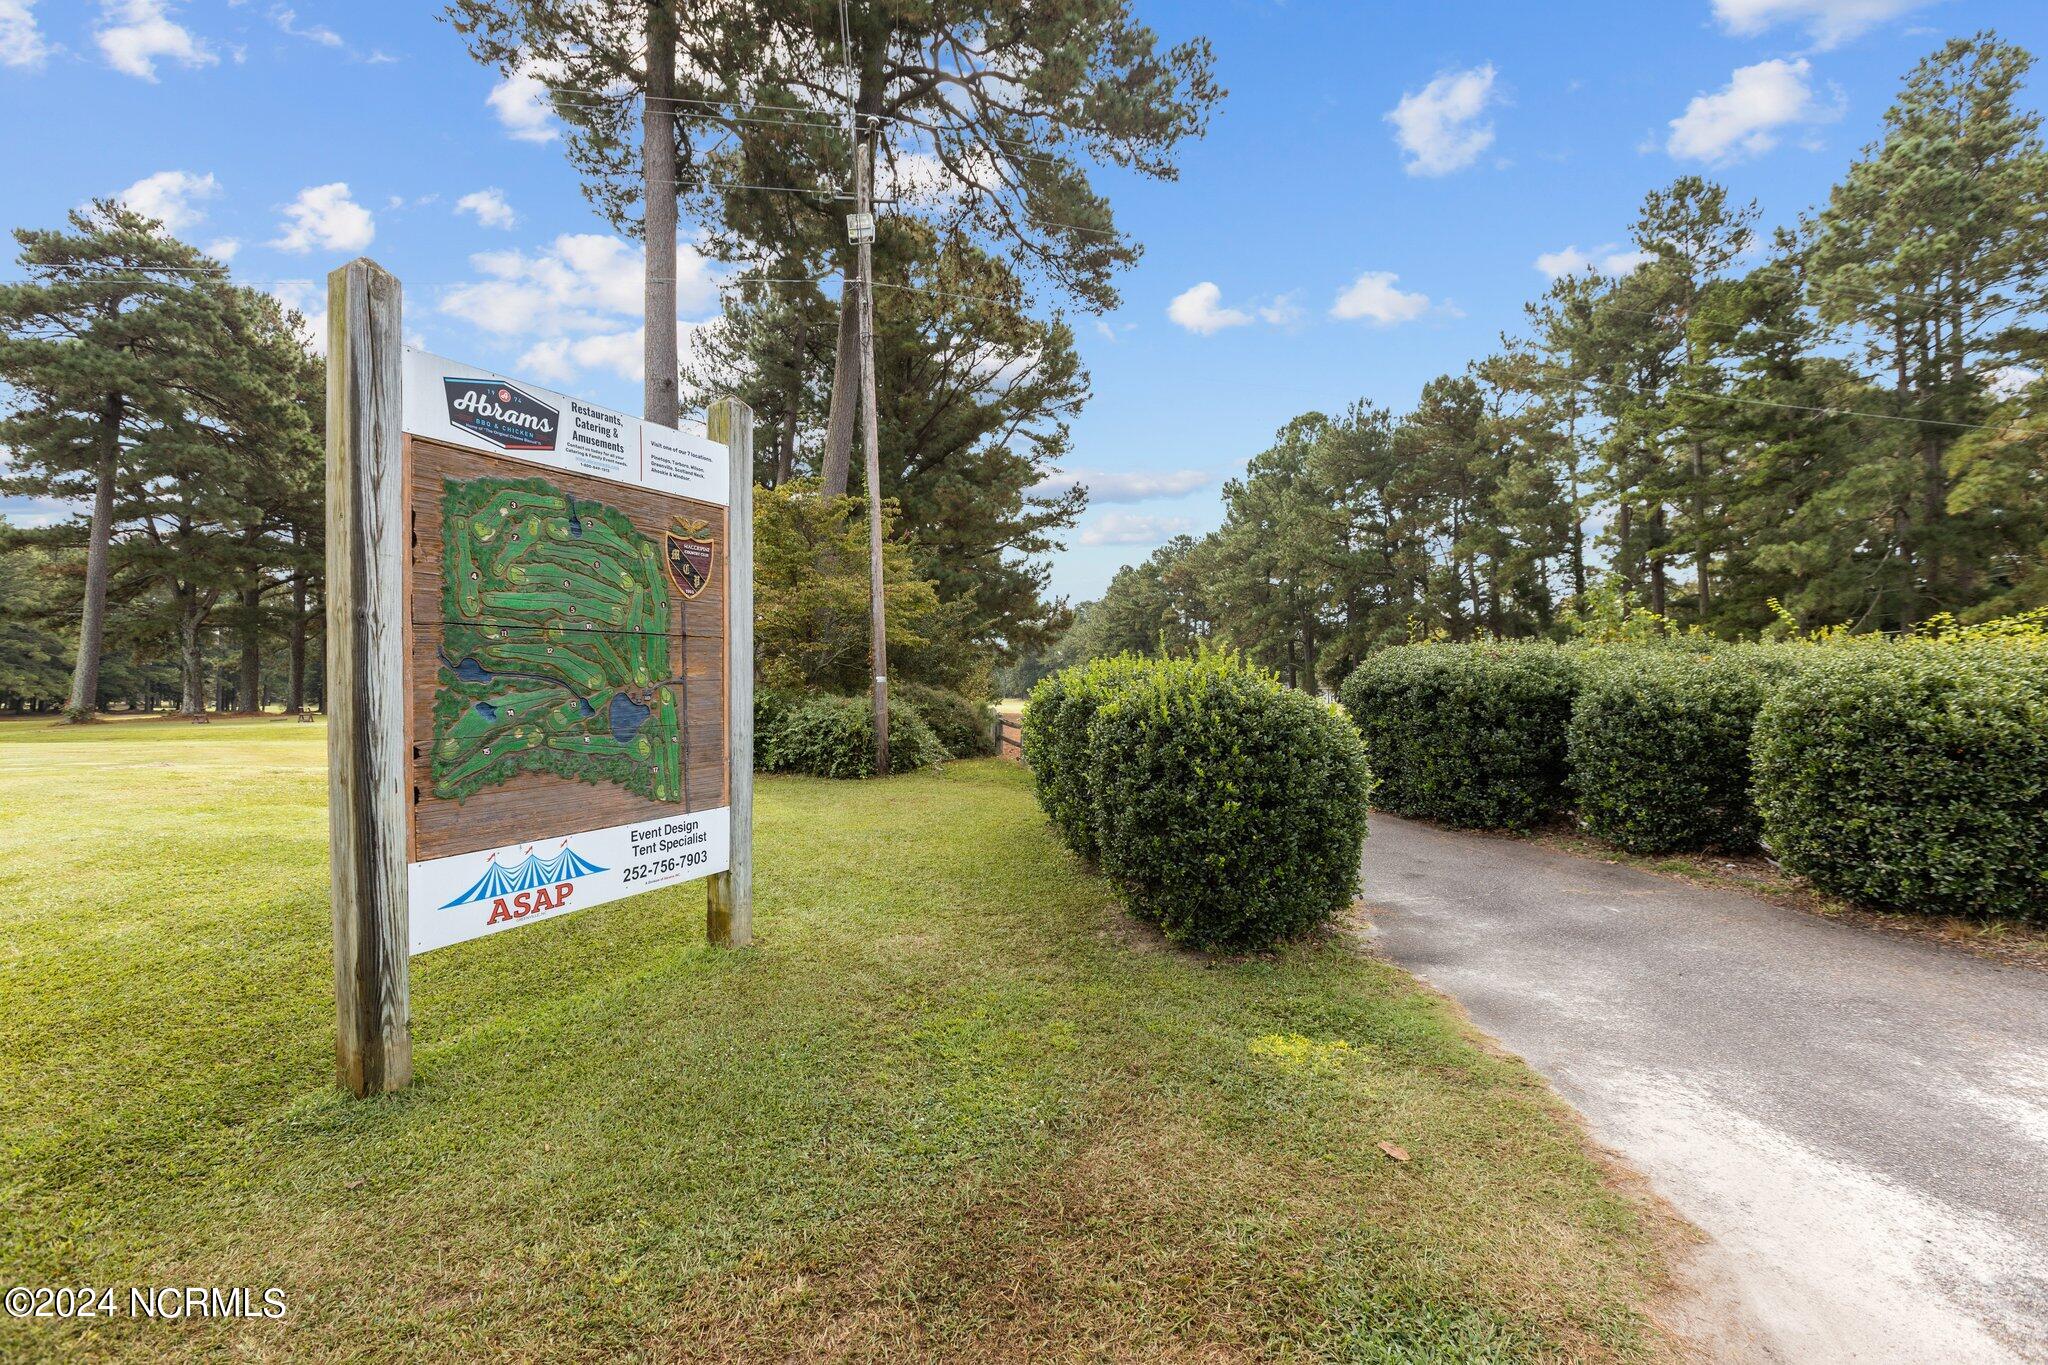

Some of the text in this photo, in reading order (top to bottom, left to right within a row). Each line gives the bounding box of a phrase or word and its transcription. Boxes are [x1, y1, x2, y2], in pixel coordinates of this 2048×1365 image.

[453, 390, 553, 432] Abrams
[475, 418, 491, 427] BBQ
[502, 425, 534, 438] CHICKEN
[575, 416, 619, 439] Catering &
[565, 447, 585, 457] Catering
[572, 430, 625, 453] Amusements
[630, 821, 699, 842] Event Design
[632, 832, 707, 857] Tent Specialist
[623, 850, 708, 883] 252-756-7903
[487, 882, 574, 926] ASAP
